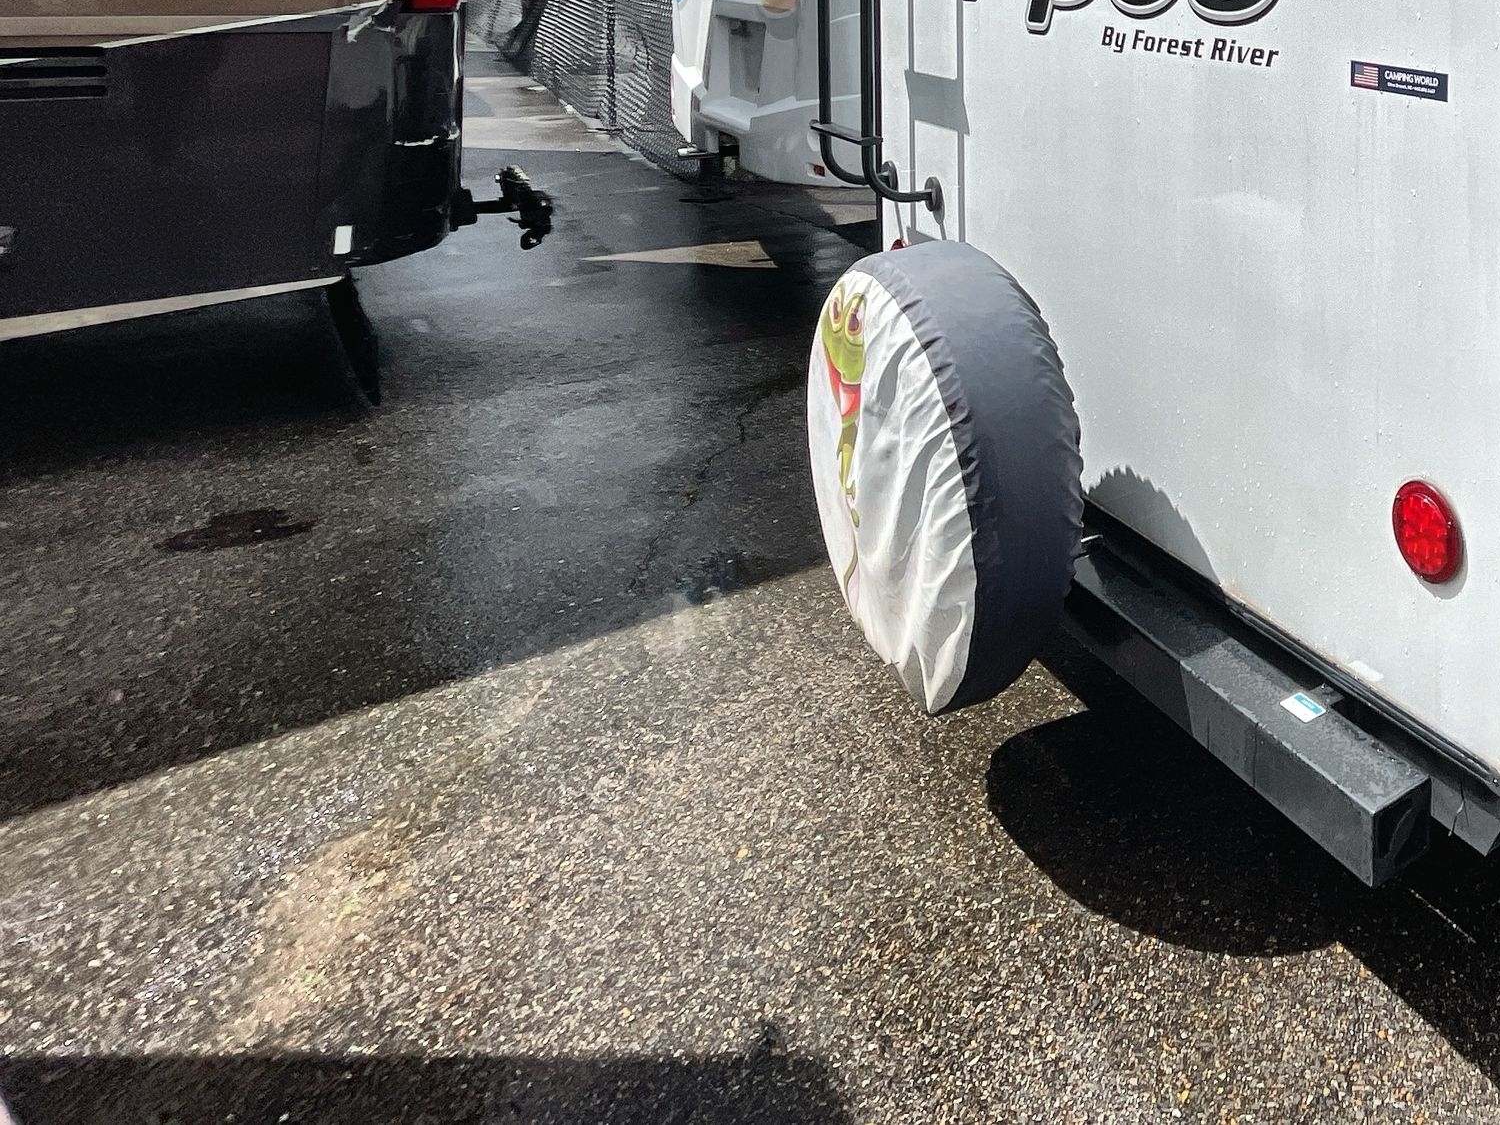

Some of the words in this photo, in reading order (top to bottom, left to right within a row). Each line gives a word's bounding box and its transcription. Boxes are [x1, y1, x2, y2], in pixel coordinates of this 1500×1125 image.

[1101, 26, 1126, 53] By
[1132, 29, 1204, 59] Forest
[1210, 37, 1280, 68] River
[1384, 70, 1414, 84] CAMPING
[1414, 74, 1439, 87] WORLD
